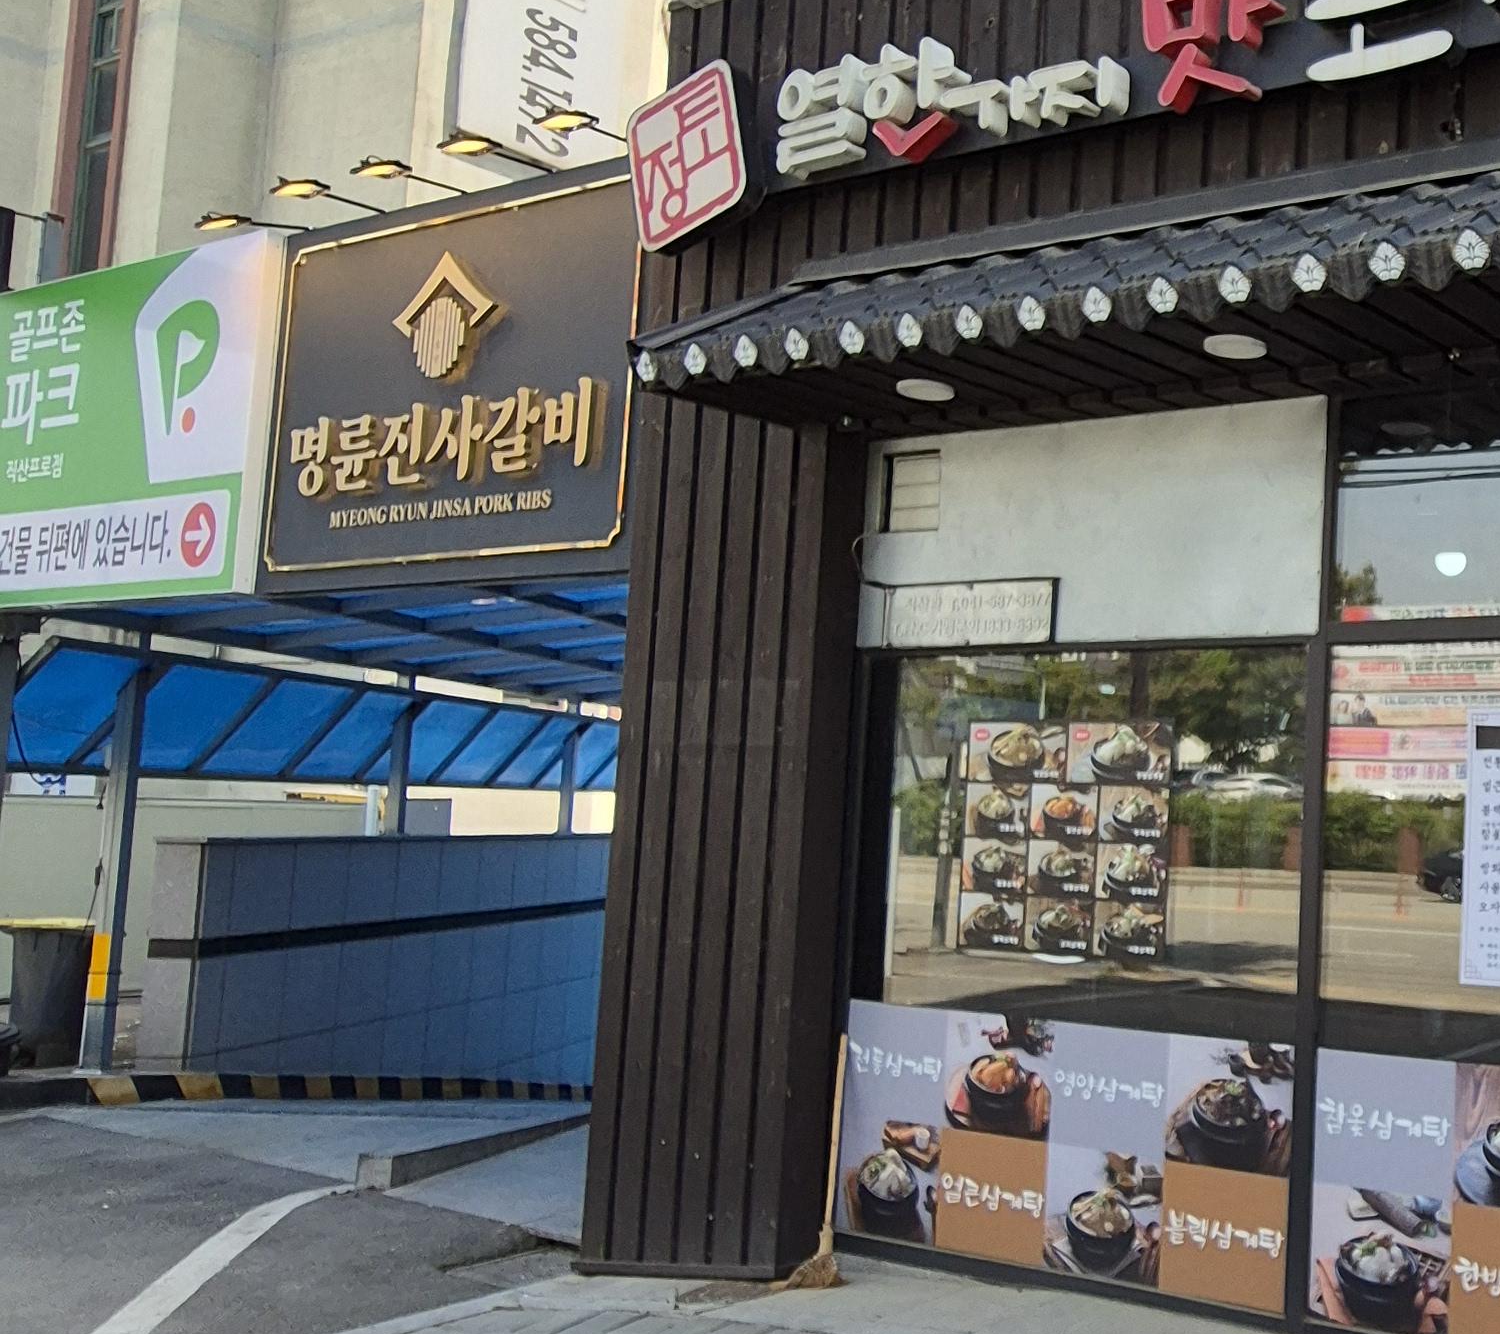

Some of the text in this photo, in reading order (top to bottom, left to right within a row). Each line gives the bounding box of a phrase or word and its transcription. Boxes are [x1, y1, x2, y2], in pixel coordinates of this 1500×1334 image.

[775, 35, 1132, 181] 열한가지
[9, 299, 87, 363] 골프존
[0, 363, 81, 445] 파크
[288, 376, 594, 497] 명륜진사갈비
[328, 488, 553, 530] MYEONG RYUN JINSA PORK RIBS
[36, 517, 91, 574] 뒤편에
[93, 509, 172, 568] 있습니다.
[849, 1040, 943, 1083] 전통삼계탕
[1054, 1069, 1166, 1108] 영양삼계탕
[940, 1171, 1046, 1218] 얼큰삼계탕
[1164, 1209, 1286, 1259] 블랙삼계탕
